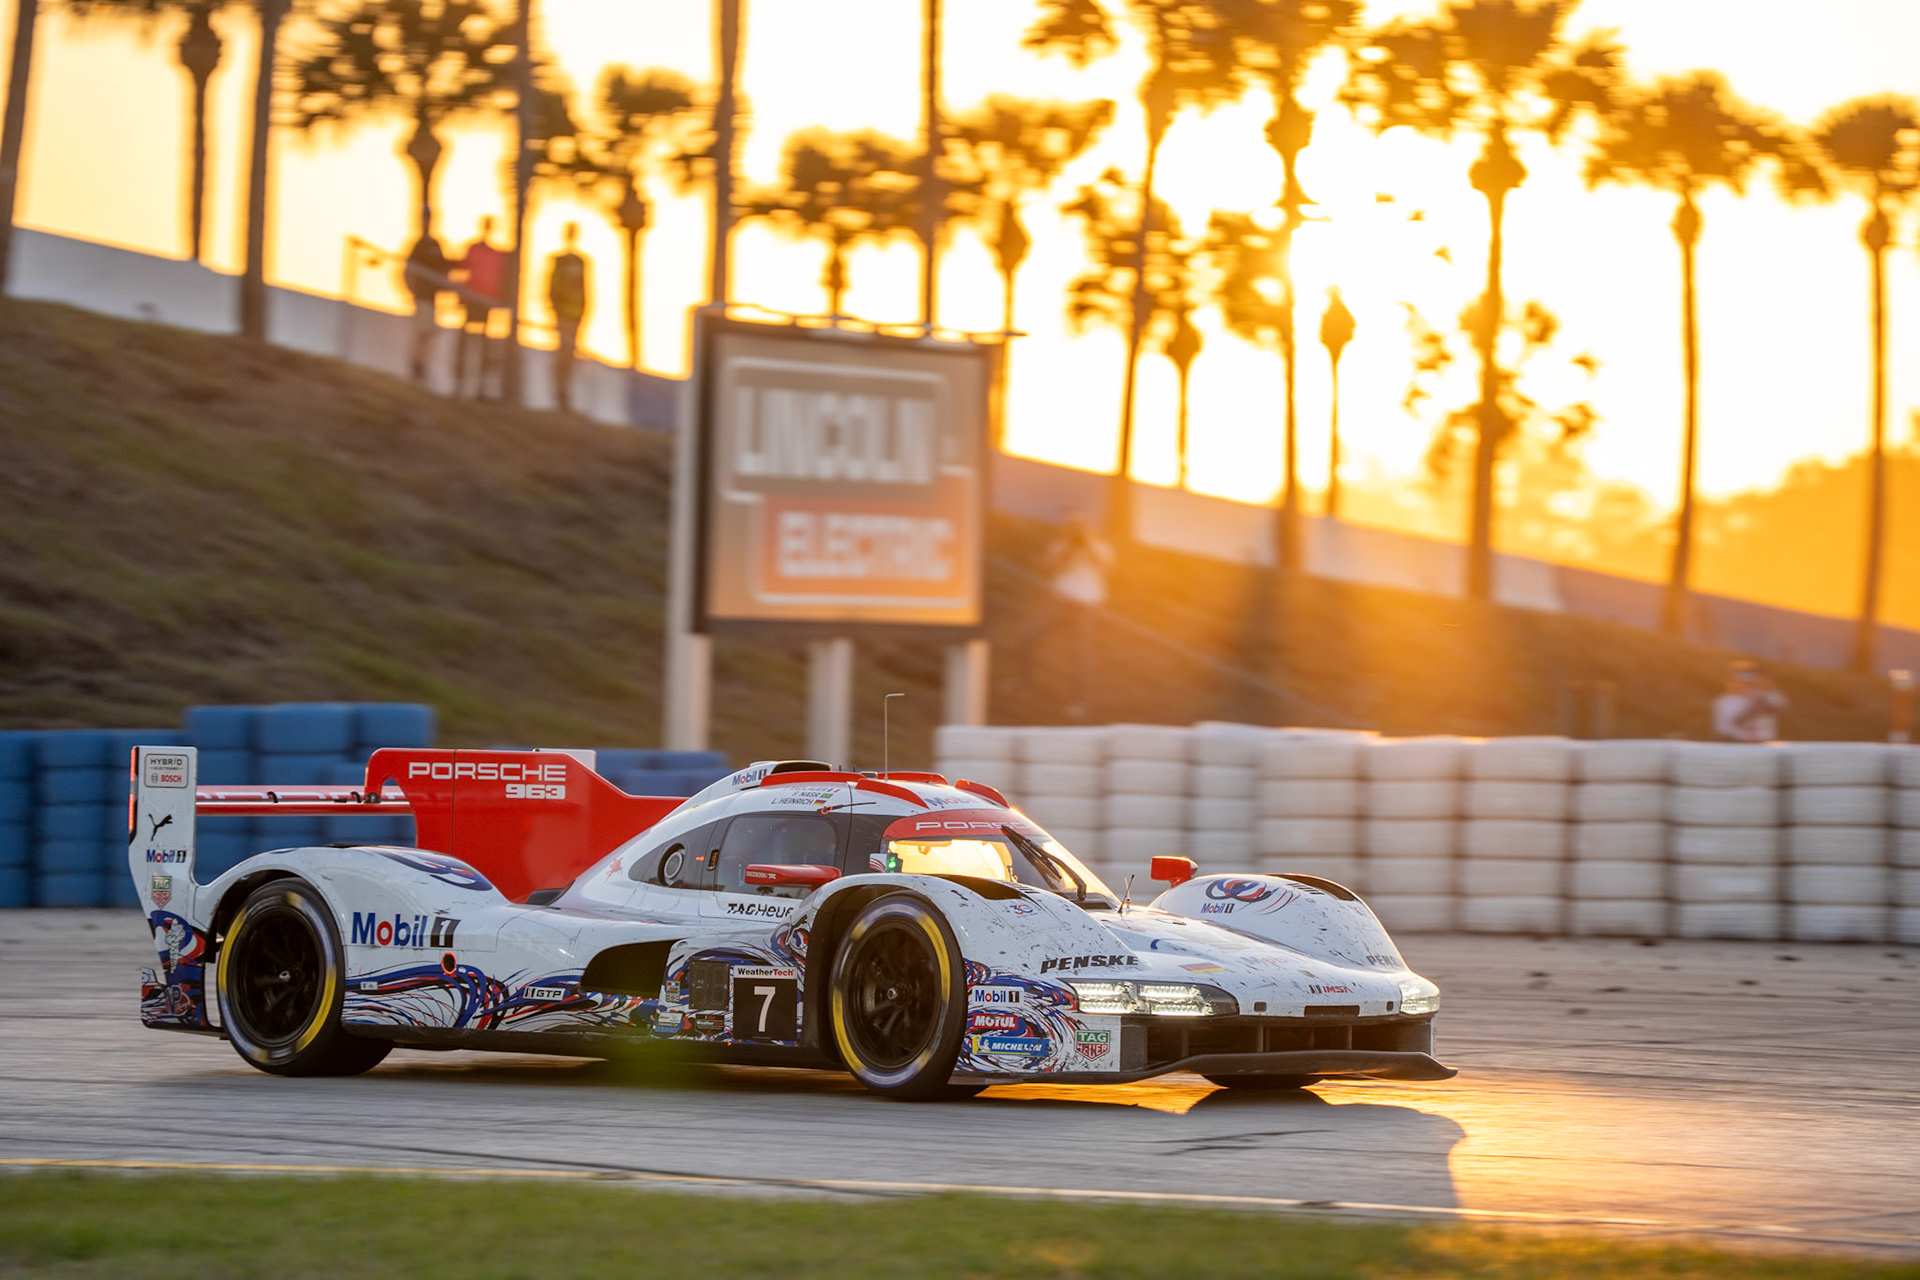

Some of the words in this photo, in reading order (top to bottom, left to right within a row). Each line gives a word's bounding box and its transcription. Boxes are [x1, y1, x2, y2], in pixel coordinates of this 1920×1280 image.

[733, 387, 932, 484] LINCOLN
[777, 511, 953, 581] ELECTRIC
[408, 762, 567, 782] PORSCHE
[732, 771, 757, 786] Mobil
[505, 783, 566, 800] 963
[915, 821, 1031, 831] PORSC
[146, 849, 175, 863] Mobil
[1201, 903, 1225, 913] Mobil
[351, 912, 428, 947] Mobil
[1040, 955, 1139, 975] PENSKE
[737, 968, 795, 977] WeatherTech
[536, 990, 562, 998] GTP
[975, 990, 1006, 1003] Mobil
[754, 986, 776, 1032] 7
[974, 1015, 1016, 1028] MOTUL
[1078, 1032, 1107, 1042] TAG
[991, 1043, 1043, 1052] MICHELIN
[1076, 1044, 1109, 1059] HEUER
